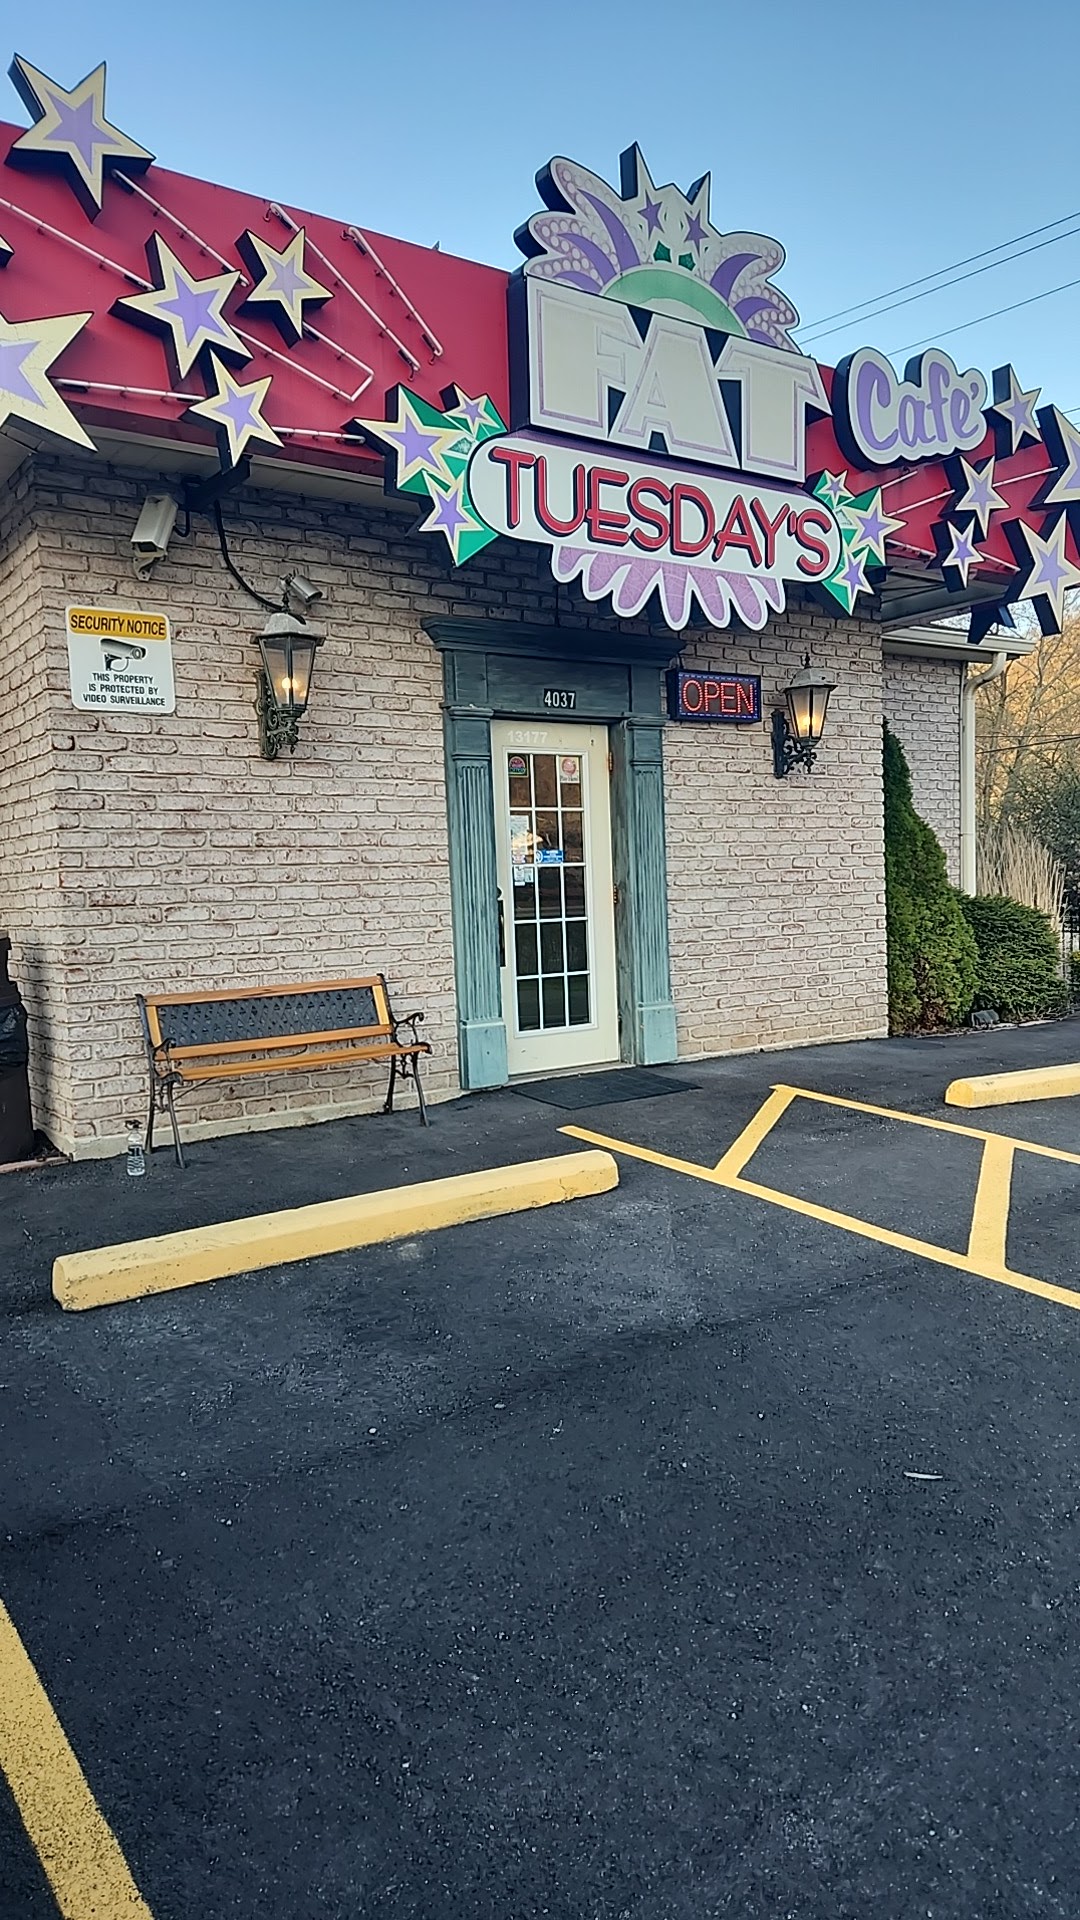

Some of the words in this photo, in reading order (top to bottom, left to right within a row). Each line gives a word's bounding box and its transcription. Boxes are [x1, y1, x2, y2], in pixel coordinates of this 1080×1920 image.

[528, 276, 832, 482] FAT
[491, 447, 831, 576] TUESDAY'S
[71, 614, 125, 632] SECURITY
[127, 618, 165, 636] NOTICE
[92, 672, 110, 682] THIS
[113, 673, 153, 685] PROPERTY
[88, 683, 96, 692] IS
[100, 683, 145, 695] PROTECTED
[148, 686, 158, 695] BY
[682, 679, 754, 713] OPEN
[83, 693, 106, 703] VIDEO
[110, 694, 165, 706] SURVEILLANCE
[544, 690, 576, 709] 4037
[507, 730, 548, 744] 13177
